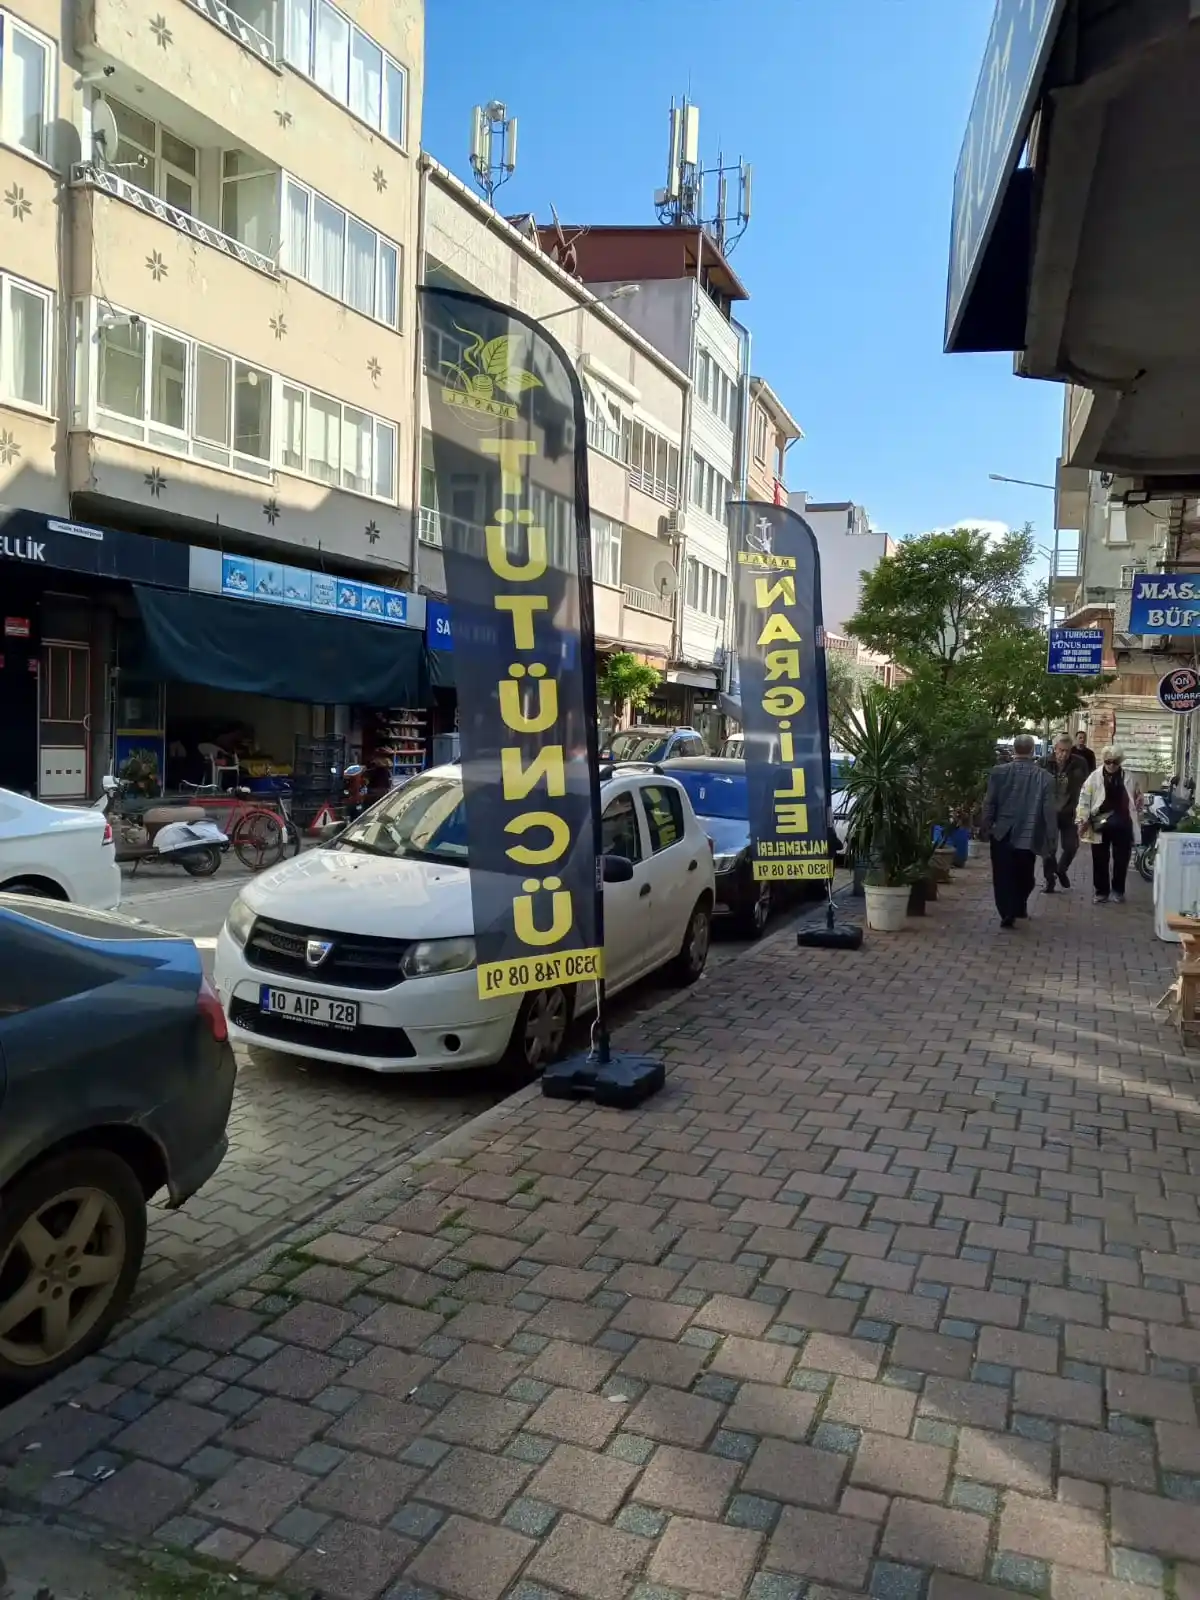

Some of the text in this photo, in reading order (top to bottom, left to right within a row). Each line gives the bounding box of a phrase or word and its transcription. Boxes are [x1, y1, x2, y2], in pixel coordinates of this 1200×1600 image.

[1137, 583, 1200, 600] MAS
[1147, 606, 1200, 627] BÜF
[1175, 677, 1189, 686] ON
[271, 991, 286, 1010] 10
[294, 996, 319, 1016] AIP
[329, 1002, 355, 1023] 128
